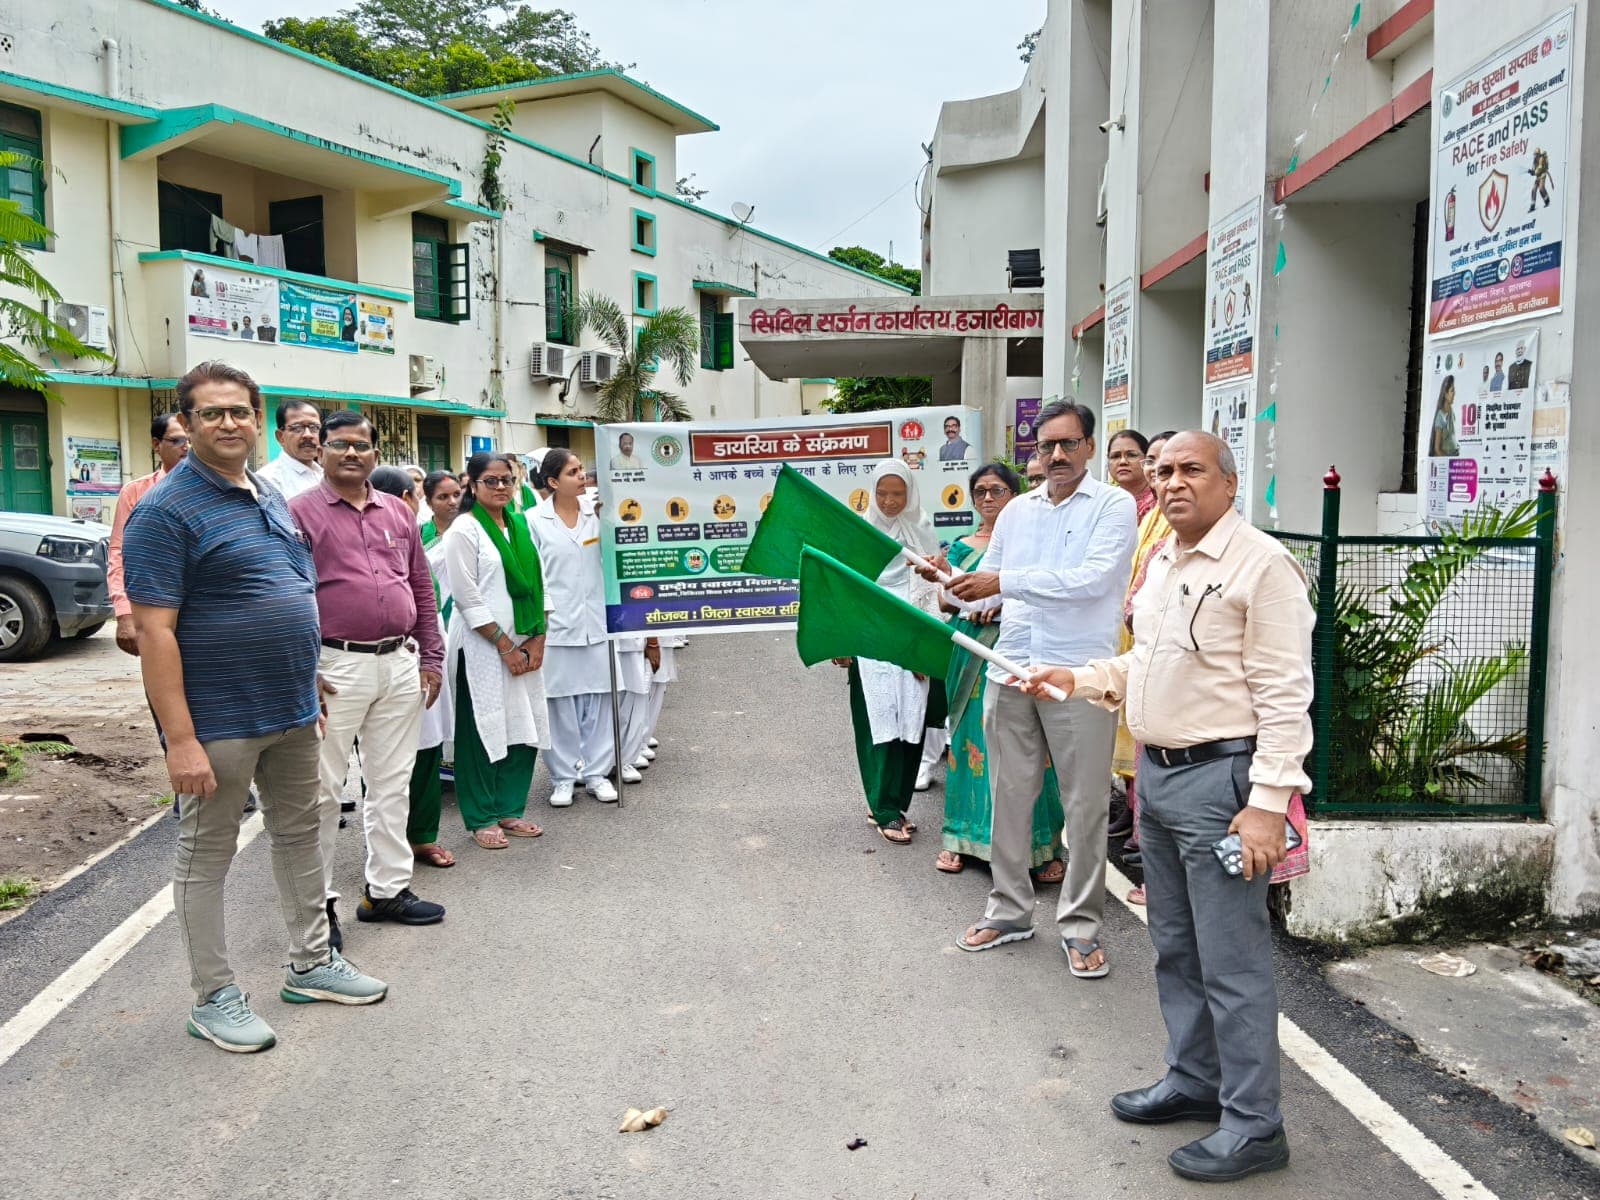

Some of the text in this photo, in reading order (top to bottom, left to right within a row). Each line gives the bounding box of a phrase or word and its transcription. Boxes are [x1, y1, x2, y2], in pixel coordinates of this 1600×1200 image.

[1481, 64, 1506, 95] सुरक्षा
[1508, 45, 1540, 76] सप्ताह
[1452, 100, 1549, 166] RACE and PASS
[1466, 137, 1529, 176] for Fire Safety
[749, 308, 814, 333] सिविल
[816, 304, 875, 333] सर्जन
[1461, 403, 1477, 426] 10
[713, 432, 870, 457] डायरिया के संक्रमण
[692, 470, 702, 481] से
[709, 468, 738, 481] आपके
[744, 467, 764, 479] बच्चे
[821, 463, 831, 475] के
[838, 463, 857, 477] लिए
[645, 609, 689, 623] सौजन्य
[701, 605, 732, 620] जिला
[735, 606, 777, 617] स्वास्थ्य
